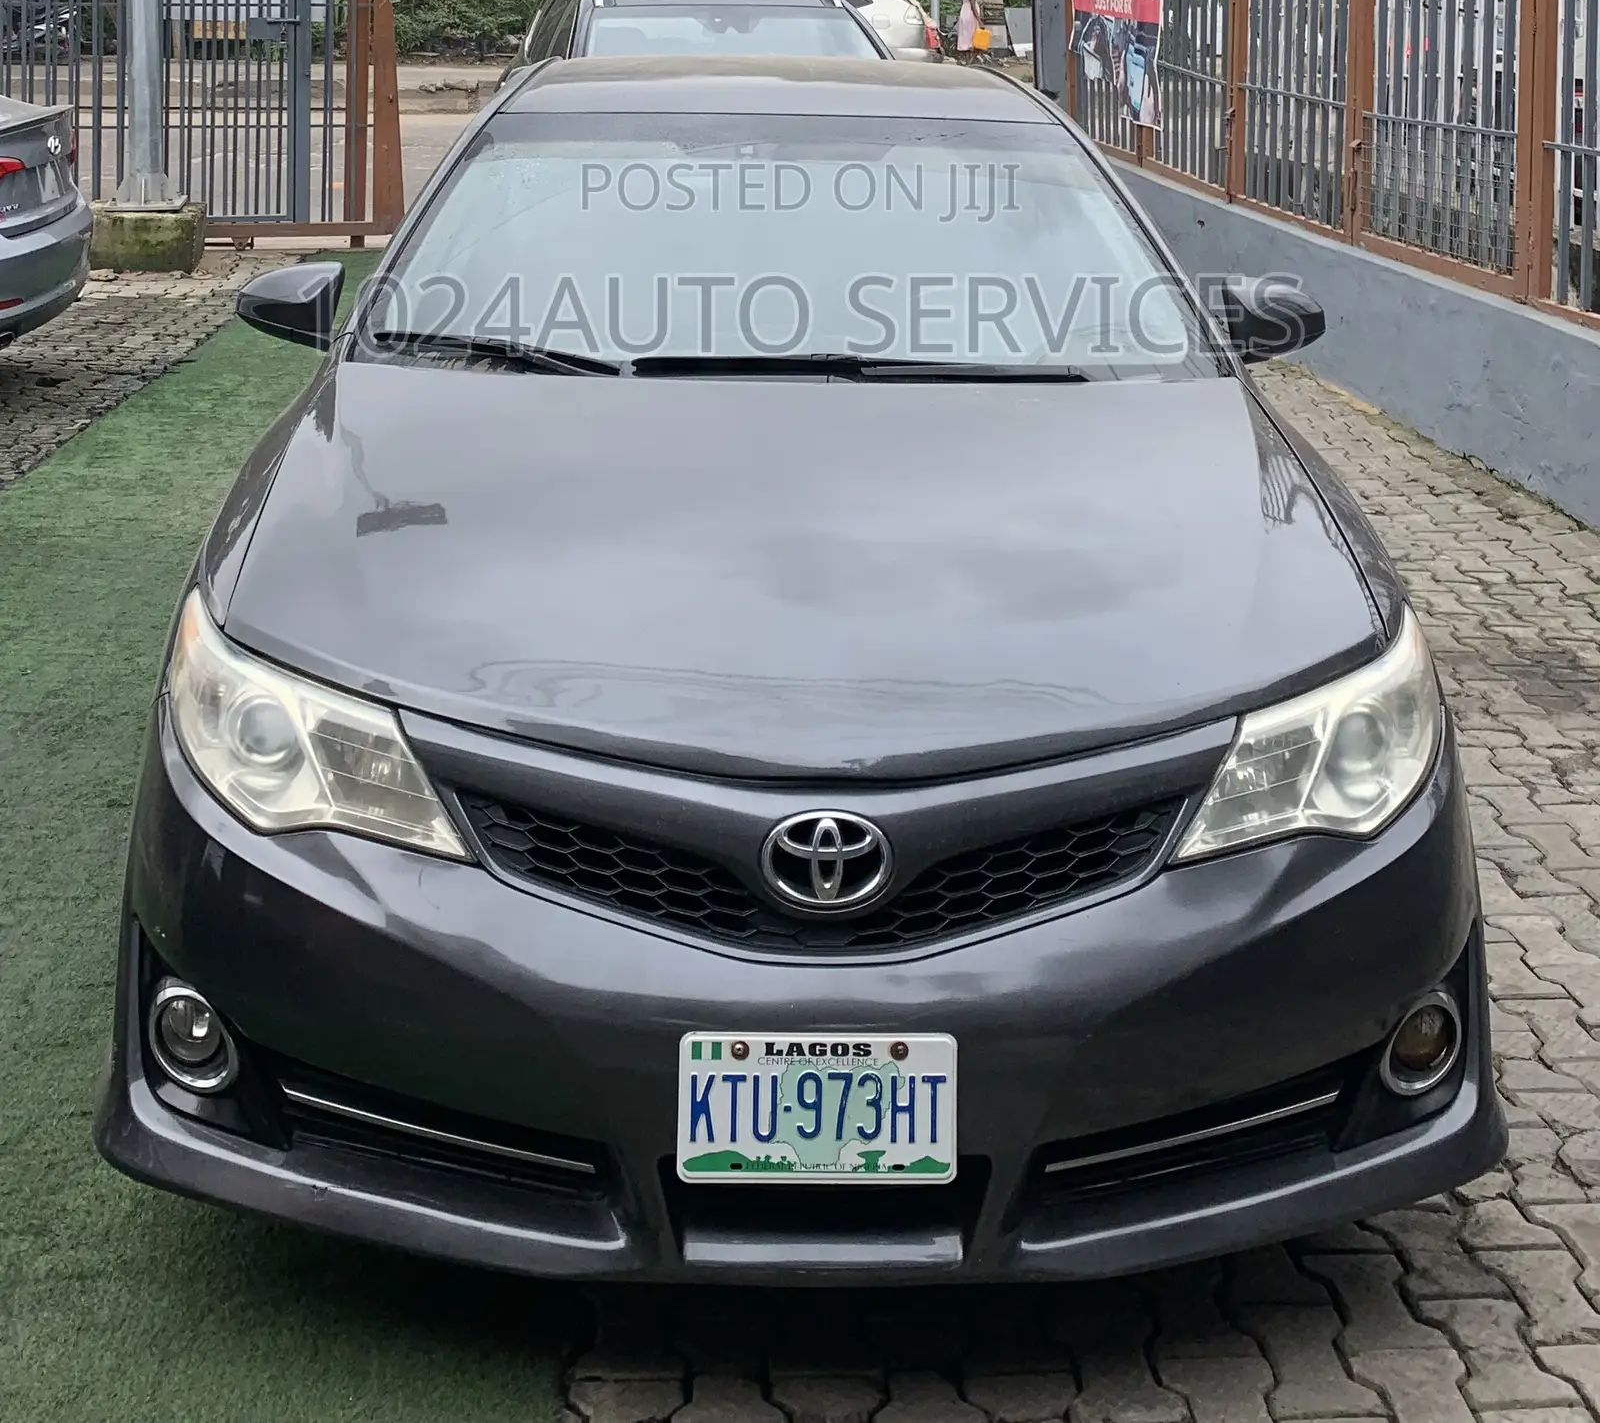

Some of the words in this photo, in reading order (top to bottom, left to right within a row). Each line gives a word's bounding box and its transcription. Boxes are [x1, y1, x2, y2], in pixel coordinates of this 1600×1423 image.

[764, 1042, 872, 1057] LAGOS
[757, 1057, 794, 1066] CENTRE
[798, 1057, 813, 1067] OF
[816, 1057, 879, 1067] EXCELLENCE
[689, 1071, 947, 1144] KTU-973HT
